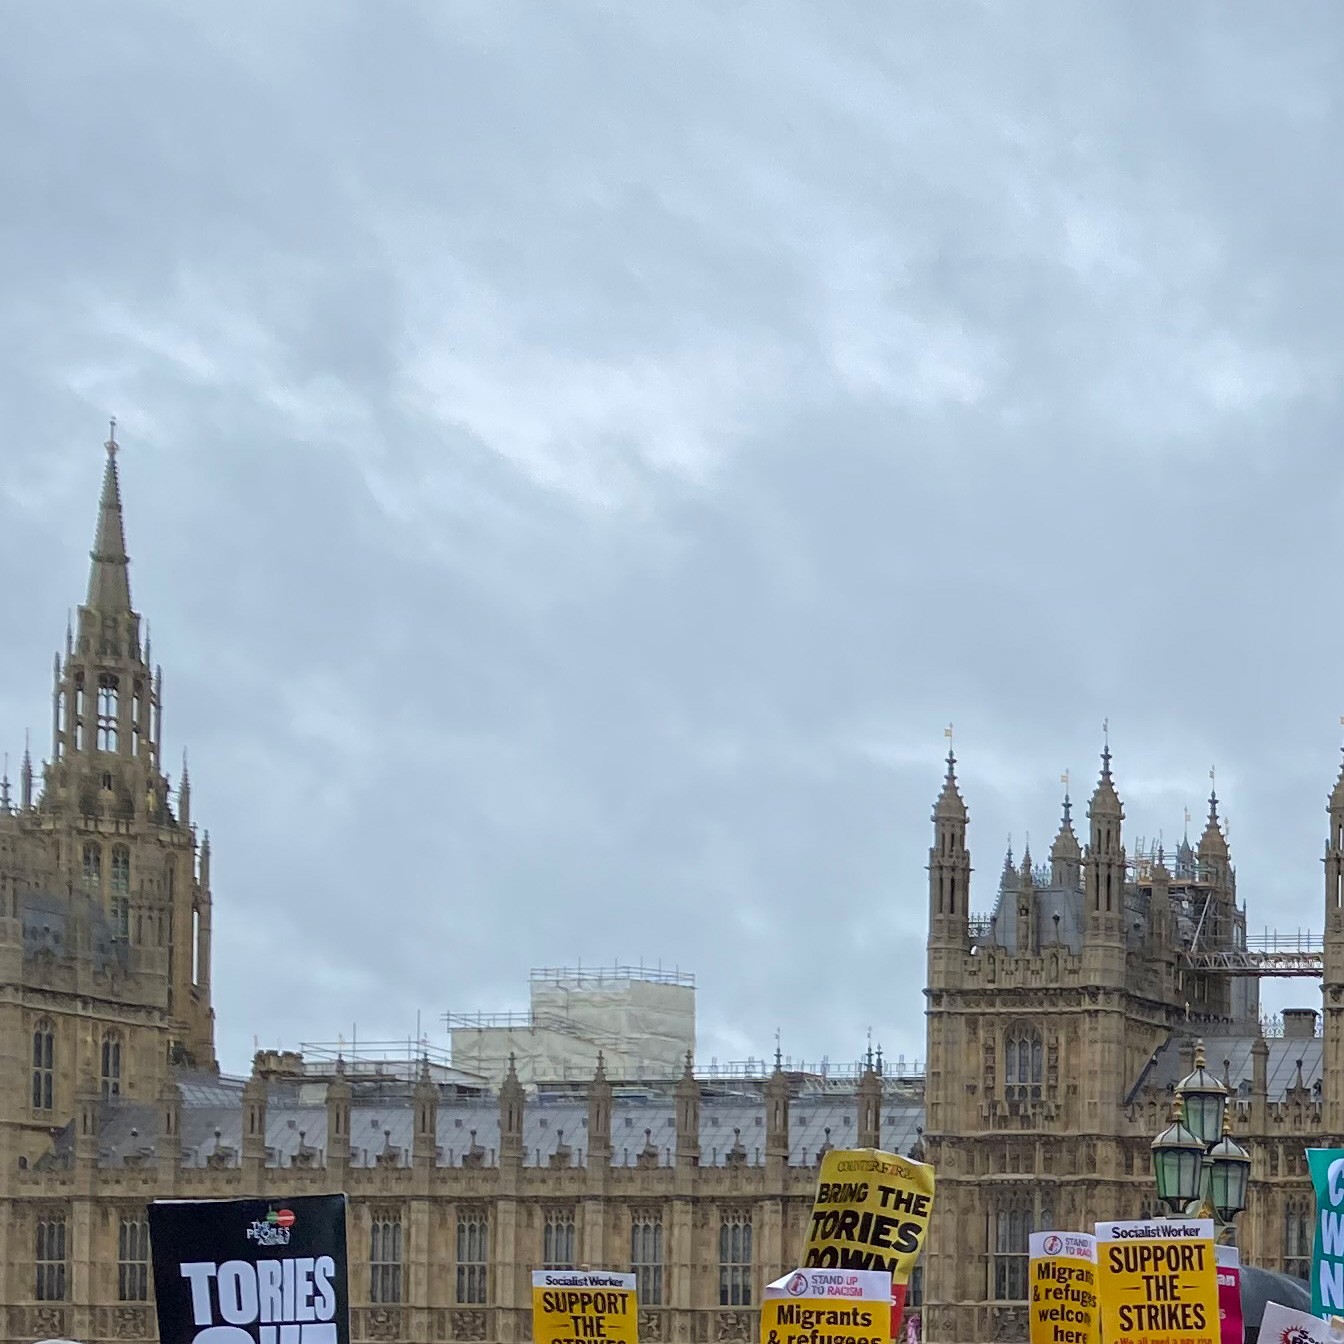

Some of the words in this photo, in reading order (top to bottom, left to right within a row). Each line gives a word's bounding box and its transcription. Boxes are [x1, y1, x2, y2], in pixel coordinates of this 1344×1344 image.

[817, 1183, 869, 1204] BRING
[878, 1185, 930, 1218] THE
[810, 1210, 922, 1253] TORIES
[1112, 1225, 1160, 1239] Socialist
[1161, 1225, 1200, 1237] Worker
[805, 1245, 899, 1283] DOWN
[1109, 1245, 1206, 1274] SUPPORT
[179, 1255, 336, 1325] TORIES
[545, 1275, 588, 1286] Socialist
[589, 1277, 623, 1287] Worker
[811, 1275, 843, 1285] STAND
[846, 1276, 858, 1286] UP
[812, 1285, 824, 1295] TO
[827, 1286, 863, 1297] RACISM
[1142, 1275, 1181, 1301] THE
[543, 1292, 628, 1315] SUPPORT
[570, 1316, 607, 1337] THE
[777, 1304, 872, 1329] Migrants
[1119, 1303, 1206, 1331] STRIKES
